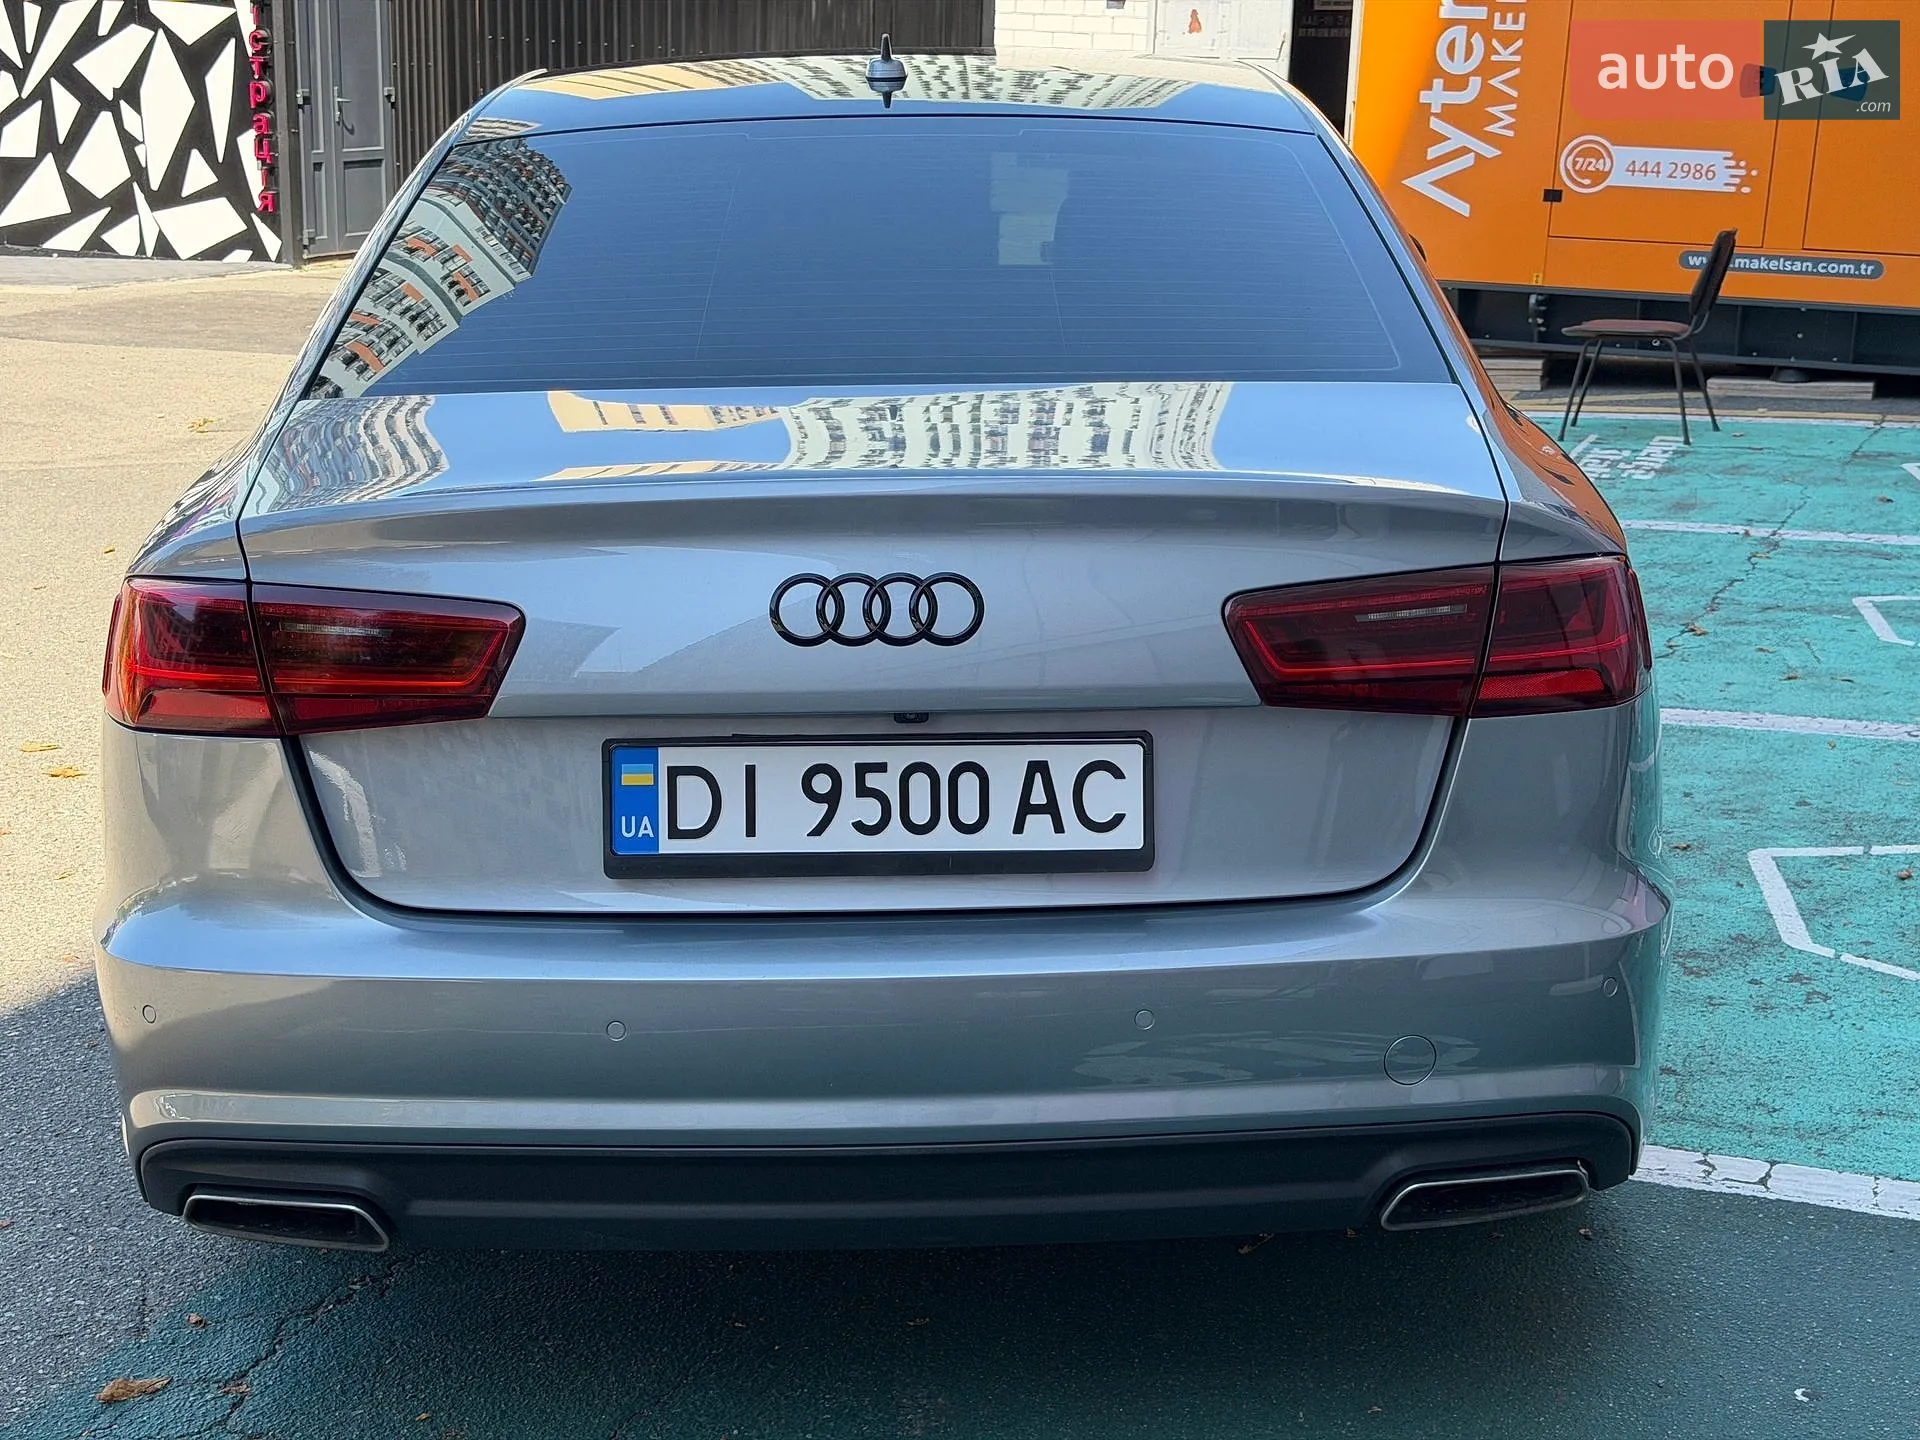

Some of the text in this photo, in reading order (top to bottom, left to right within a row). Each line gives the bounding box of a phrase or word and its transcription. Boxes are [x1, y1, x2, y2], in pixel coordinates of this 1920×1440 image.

[1484, 0, 1528, 137] MAKE
[1574, 157, 1607, 171] 7/24
[1625, 160, 1717, 181] 444 2986
[1687, 254, 1875, 276] w.makelsan.com.tr
[666, 759, 1127, 840] DI 9500 AC
[620, 815, 655, 839] UA
